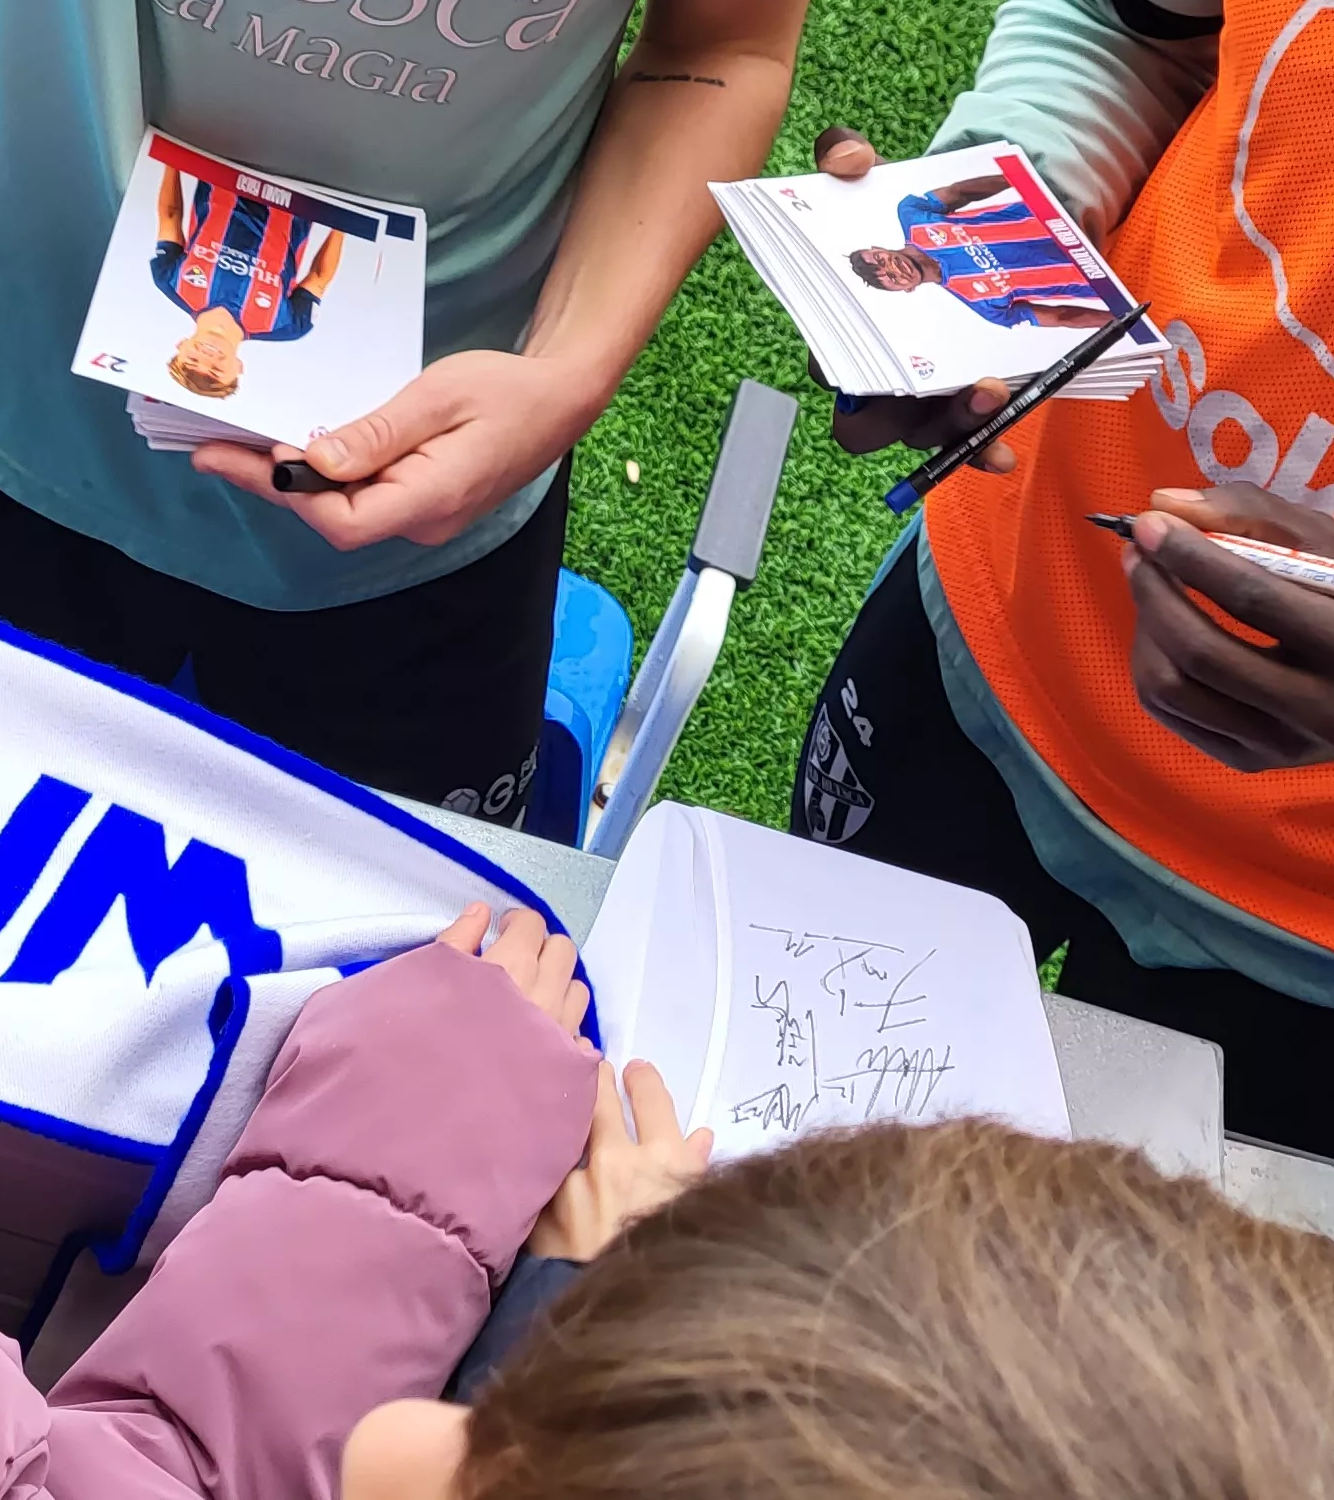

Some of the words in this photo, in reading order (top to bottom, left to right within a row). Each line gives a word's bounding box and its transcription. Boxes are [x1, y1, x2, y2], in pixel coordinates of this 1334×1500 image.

[778, 187, 813, 212] 24
[90, 352, 129, 373] 27
[840, 677, 875, 748] 24
